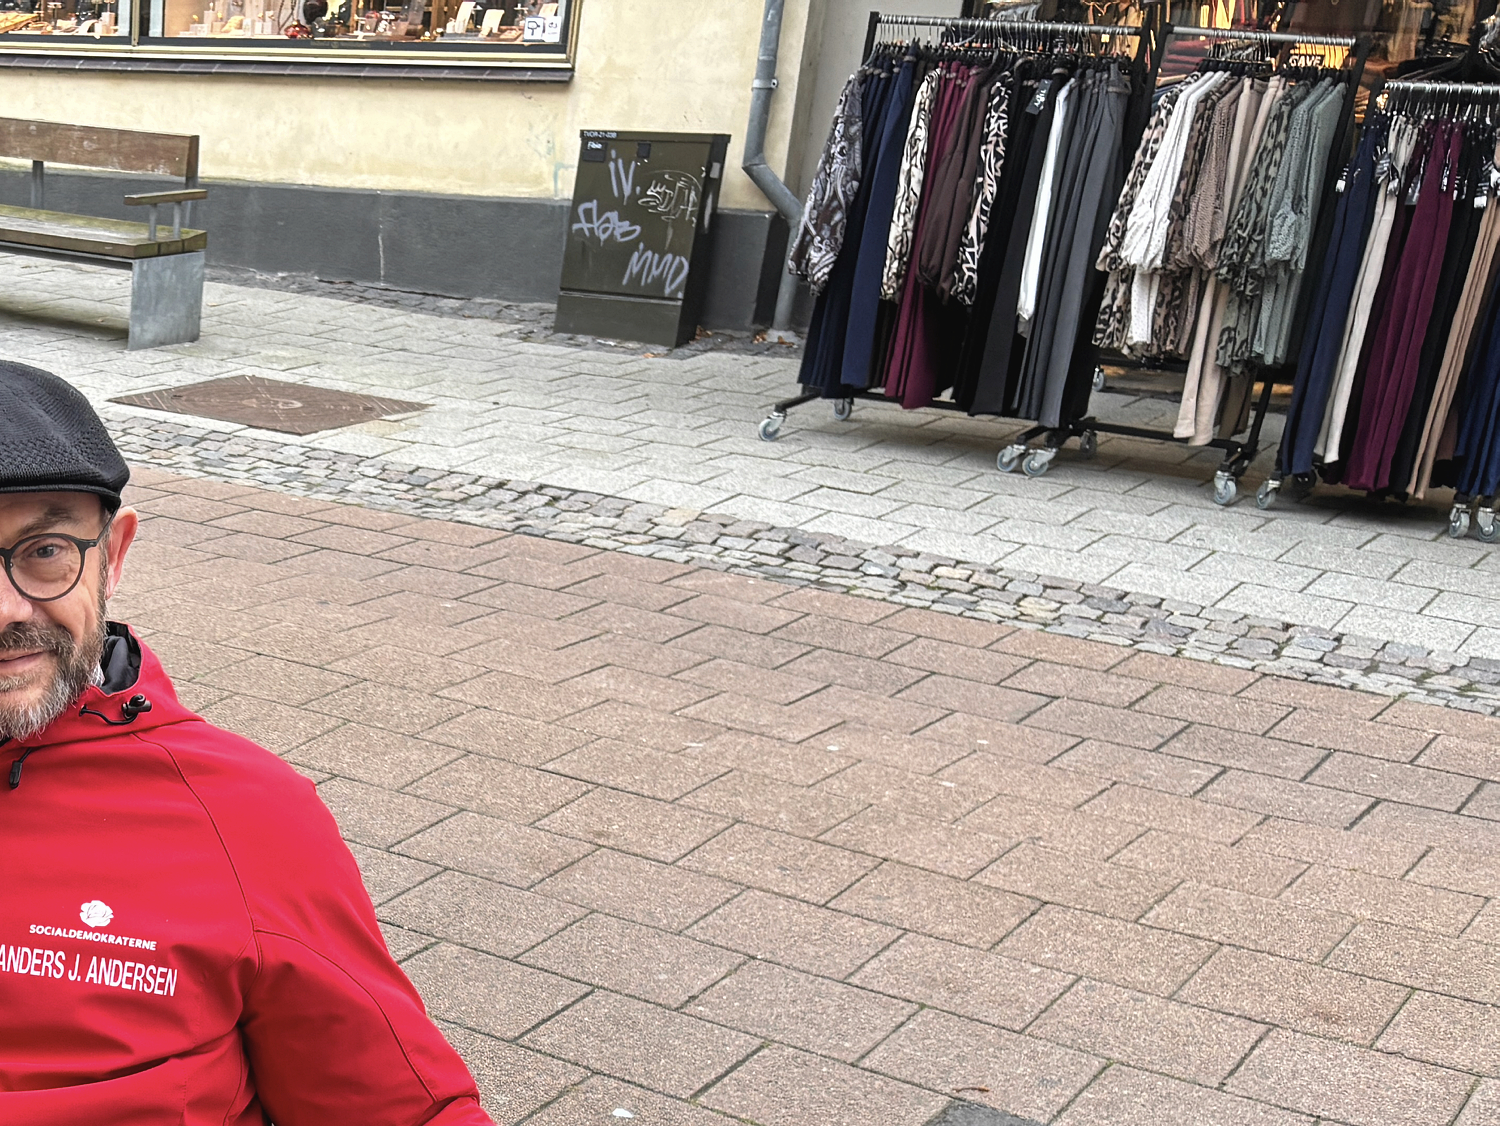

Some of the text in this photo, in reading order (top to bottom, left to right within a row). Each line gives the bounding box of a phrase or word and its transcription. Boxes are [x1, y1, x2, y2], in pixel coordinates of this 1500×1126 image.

[29, 924, 157, 951] SOCIALDEMOKRATERNE
[67, 953, 81, 982] J.
[85, 955, 178, 997] ANDERSEN
